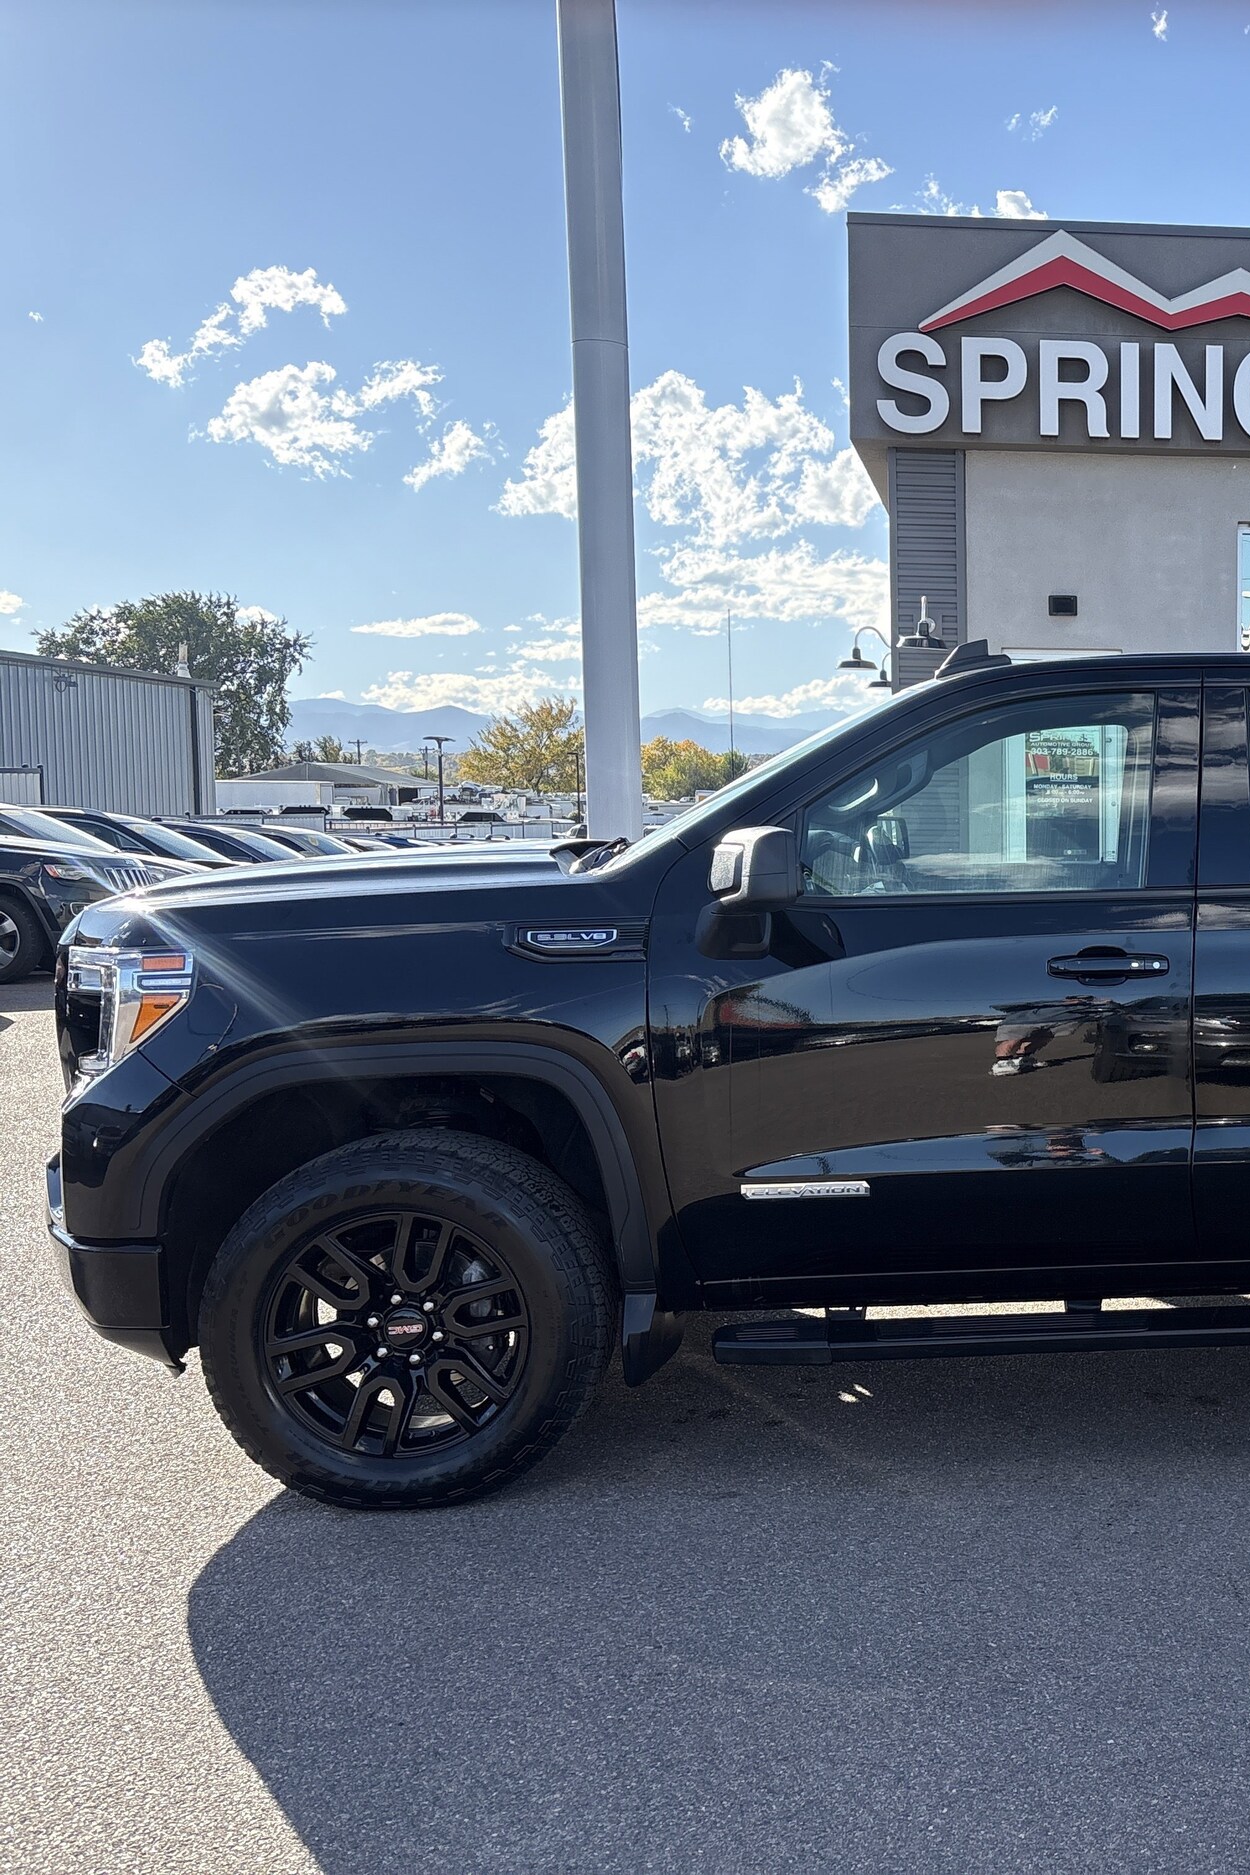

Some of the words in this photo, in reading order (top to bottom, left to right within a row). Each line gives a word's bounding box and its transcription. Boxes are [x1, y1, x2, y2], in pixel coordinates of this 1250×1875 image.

[1030, 747, 1094, 756] 303-789-2886
[1050, 773, 1078, 781] HOURS
[748, 1185, 863, 1197] ELEVATION
[387, 1323, 424, 1336] GMC
